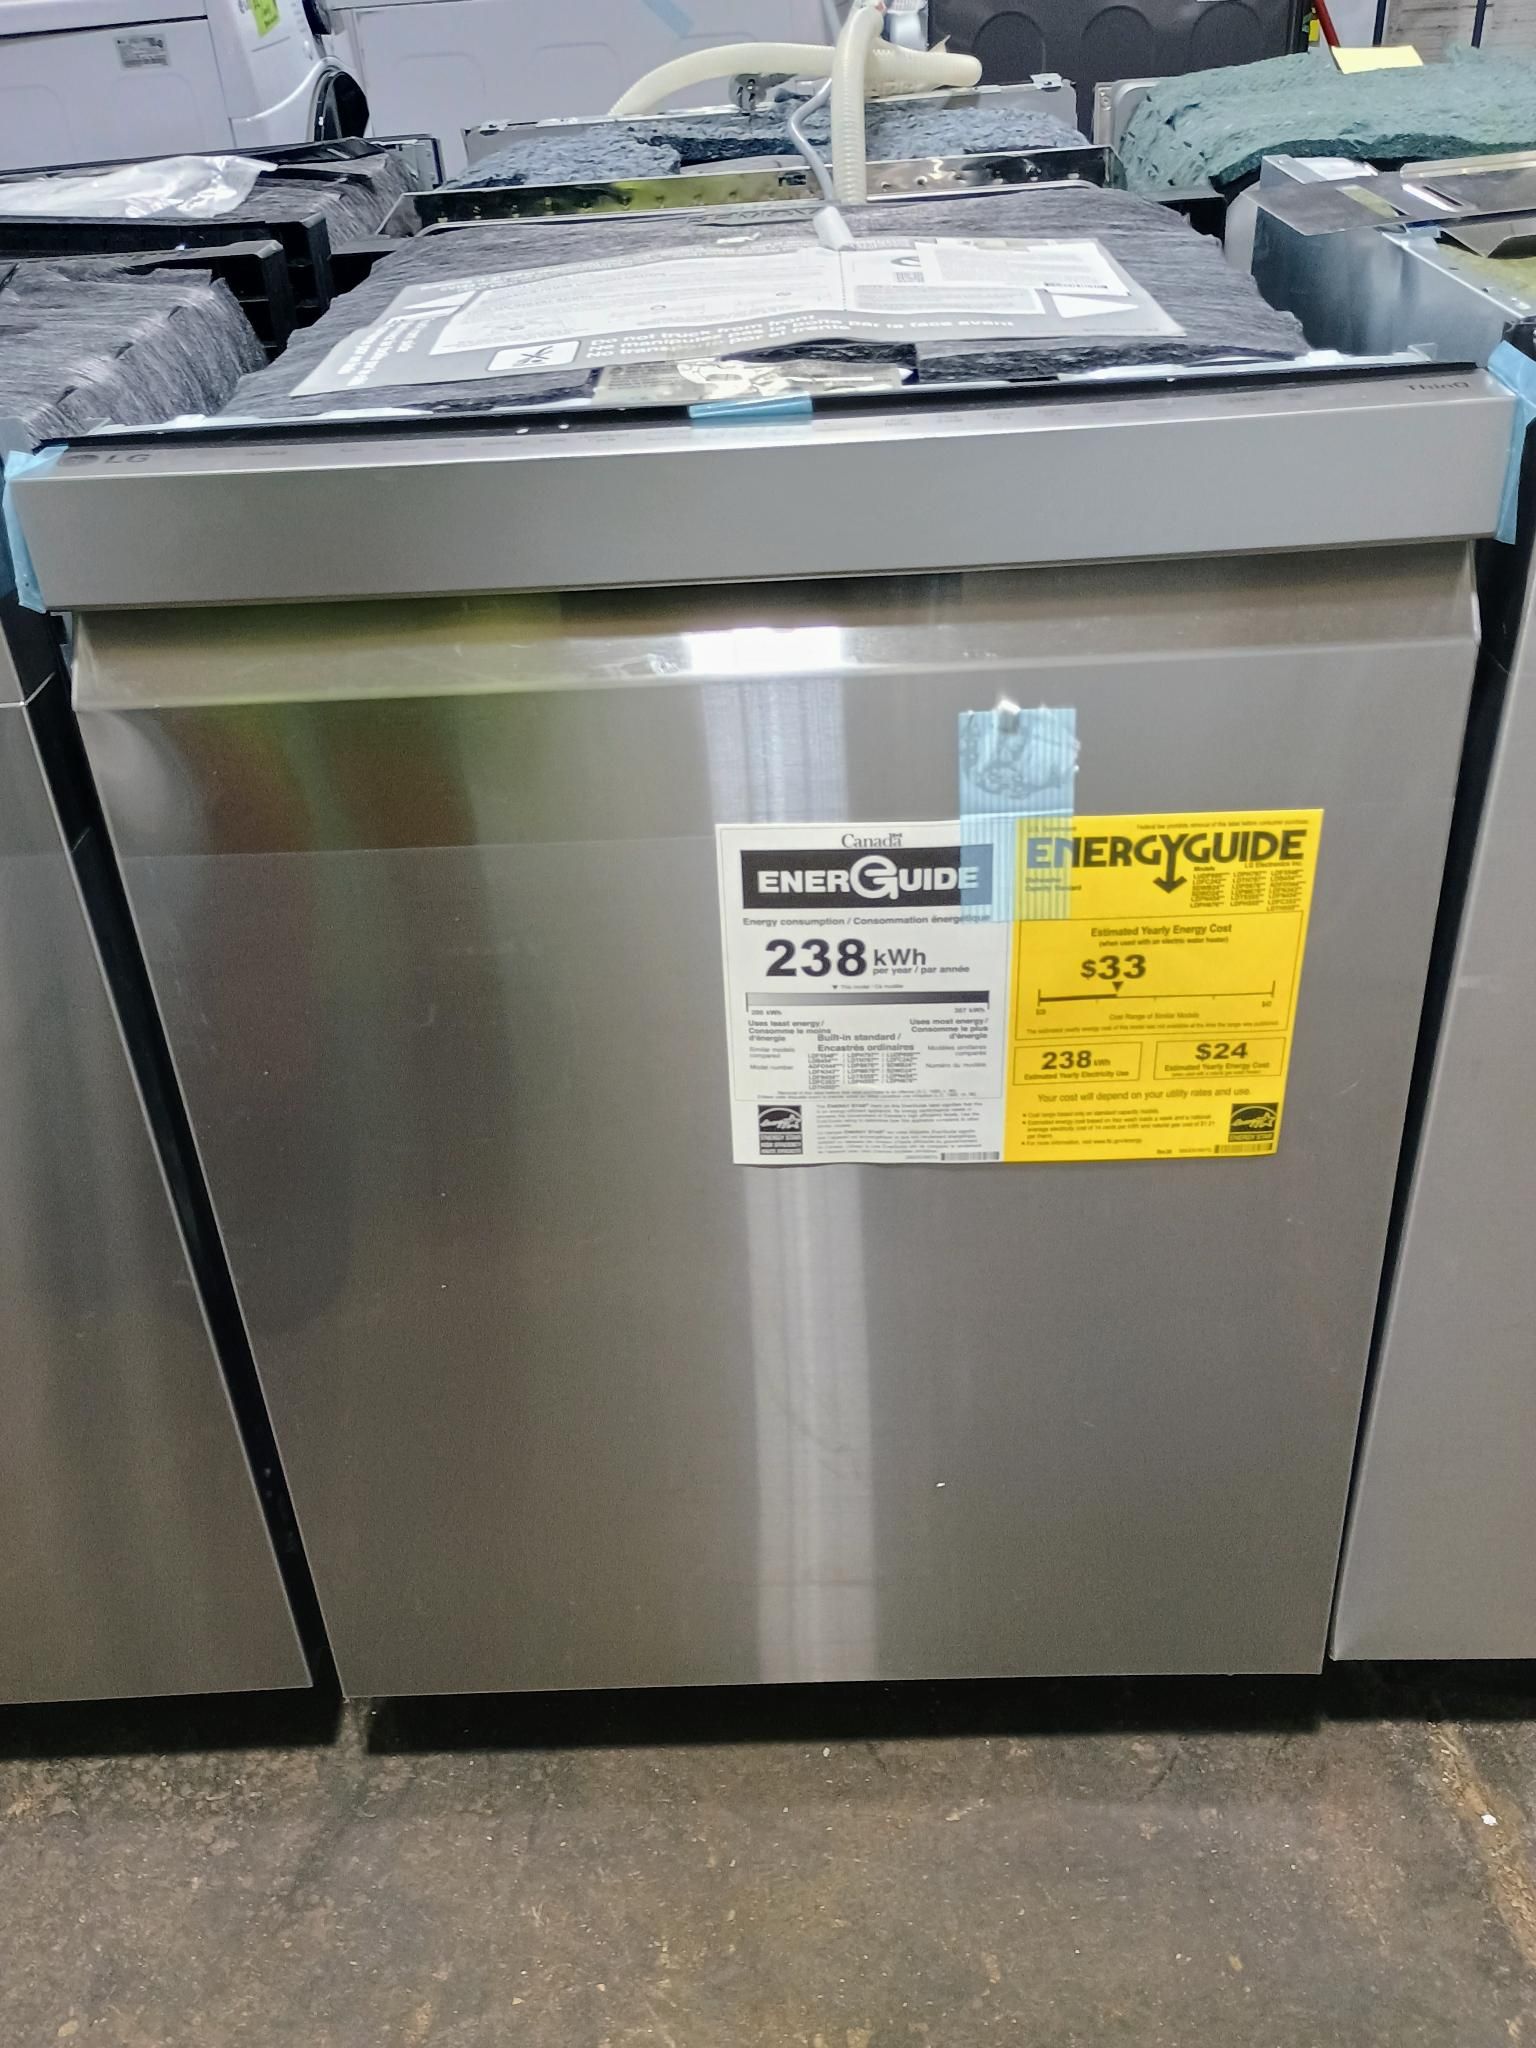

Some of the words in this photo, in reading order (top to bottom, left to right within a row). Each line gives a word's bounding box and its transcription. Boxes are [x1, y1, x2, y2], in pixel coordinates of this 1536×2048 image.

[105, 454, 150, 464] LG
[842, 834, 902, 848] Canada
[1026, 829, 1308, 874] ENERGYGUIDE
[758, 854, 980, 900] ENERGUIDE
[743, 918, 778, 928] Energy
[780, 917, 845, 928] consumption
[854, 916, 928, 925] Consommation
[1091, 927, 1139, 938] Estimated
[1141, 926, 1170, 937] Yearly
[1173, 924, 1207, 936] Energy
[1210, 923, 1232, 934] Cost
[766, 938, 868, 978] 238
[874, 949, 926, 966] kWh
[872, 968, 888, 976] per
[892, 967, 912, 976] year
[921, 966, 937, 975] par
[939, 965, 970, 974] année
[1080, 954, 1147, 980] $33
[792, 1020, 820, 1028] energy
[817, 1033, 852, 1042] Built-in
[854, 1032, 896, 1042] standard
[818, 1044, 864, 1052] Encastrés
[867, 1043, 914, 1052] ordinaires
[1195, 1042, 1248, 1061] $24
[1041, 1050, 1092, 1070] 238
[1164, 1064, 1200, 1072] Estimated
[1202, 1063, 1224, 1072] Yearly
[1225, 1062, 1250, 1071] Energy
[1024, 1072, 1058, 1080] Estimated
[1059, 1072, 1080, 1080] Yearly
[1037, 1093, 1058, 1104] Your
[1059, 1093, 1078, 1102] cost
[1080, 1092, 1094, 1101] will
[1096, 1091, 1129, 1102] depend
[1131, 1092, 1142, 1100] on
[1143, 1091, 1164, 1102] your
[1165, 1088, 1188, 1100] utility
[1190, 1088, 1213, 1098] rates
[1214, 1087, 1232, 1097] and
